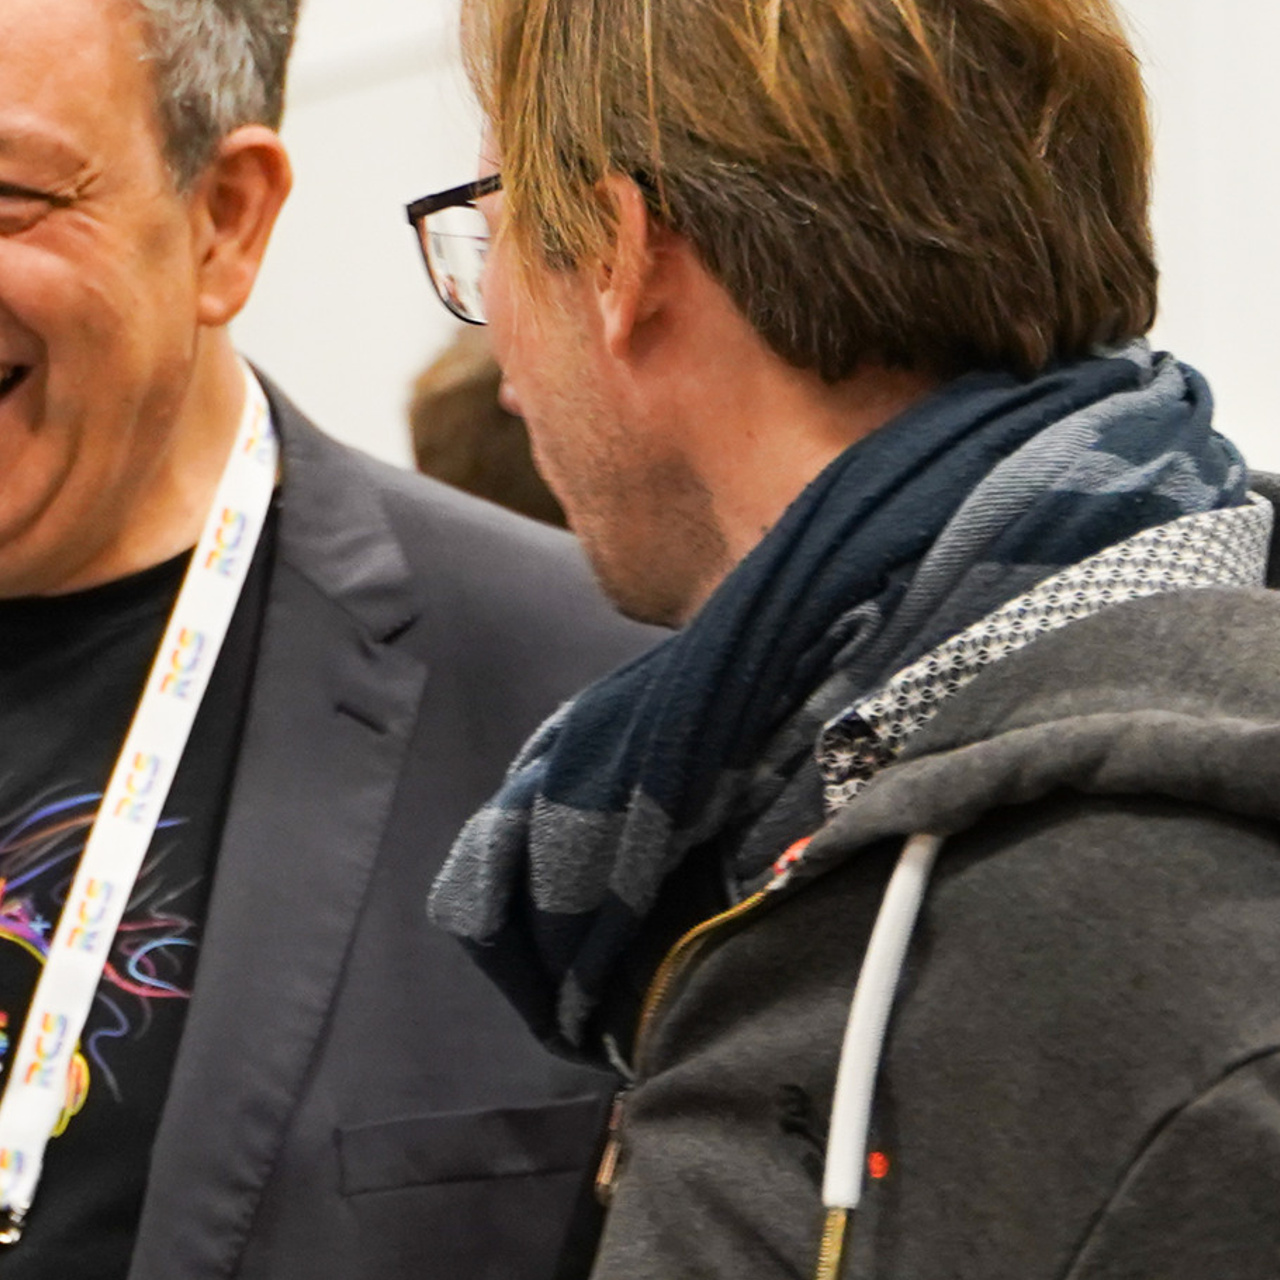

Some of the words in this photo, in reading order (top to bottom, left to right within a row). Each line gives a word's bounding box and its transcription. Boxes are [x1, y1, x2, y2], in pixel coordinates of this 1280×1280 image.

[205, 507, 246, 576] RCS
[160, 627, 205, 700] RCS
[114, 751, 161, 823] RCS
[66, 877, 114, 952] RCS
[22, 1011, 68, 1087] RCS
